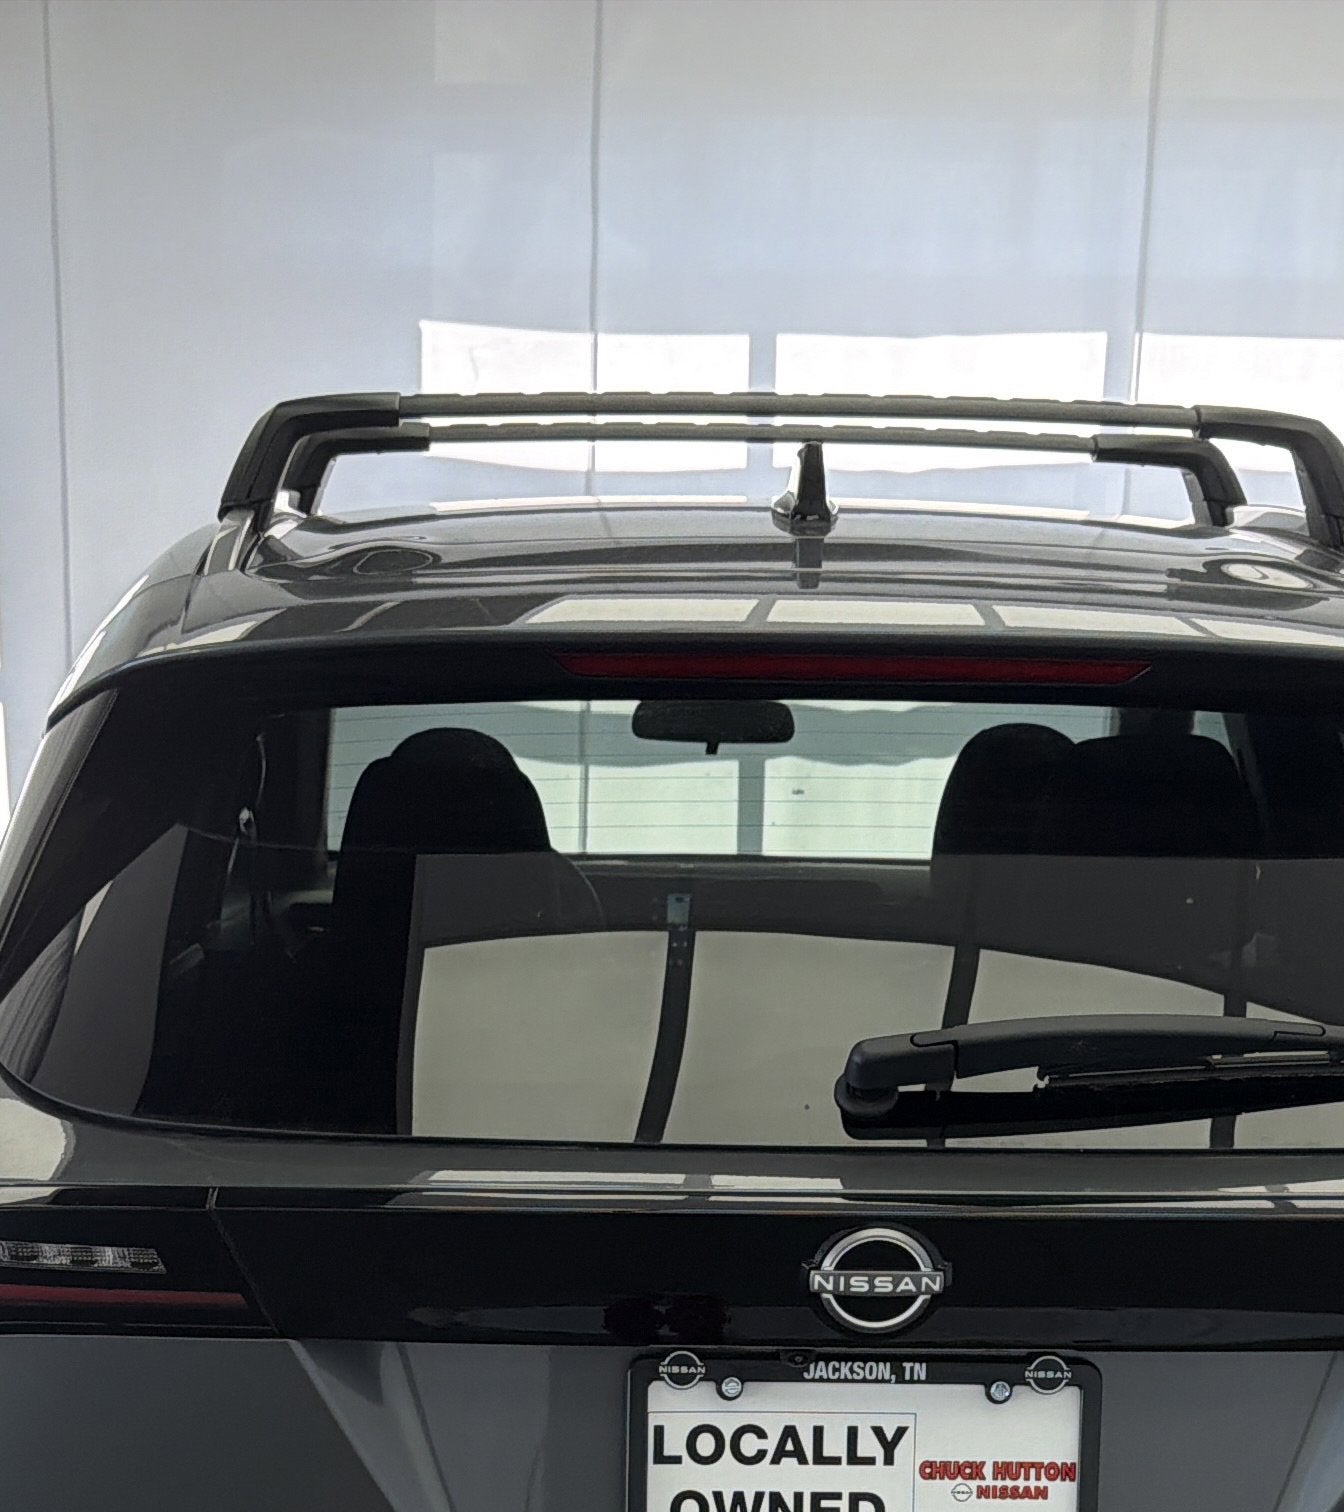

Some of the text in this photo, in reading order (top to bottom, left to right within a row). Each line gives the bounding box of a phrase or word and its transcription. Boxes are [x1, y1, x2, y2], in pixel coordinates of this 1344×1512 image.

[813, 1274, 941, 1292] NISSAN
[659, 1365, 705, 1374] NISSAN
[803, 1361, 927, 1383] JACKSON, TN
[1025, 1369, 1072, 1379] NISSAN
[653, 1424, 910, 1466] LOCALLY
[919, 1460, 1076, 1482] CHUCK HUTTON
[976, 1485, 1048, 1500] NISSAN
